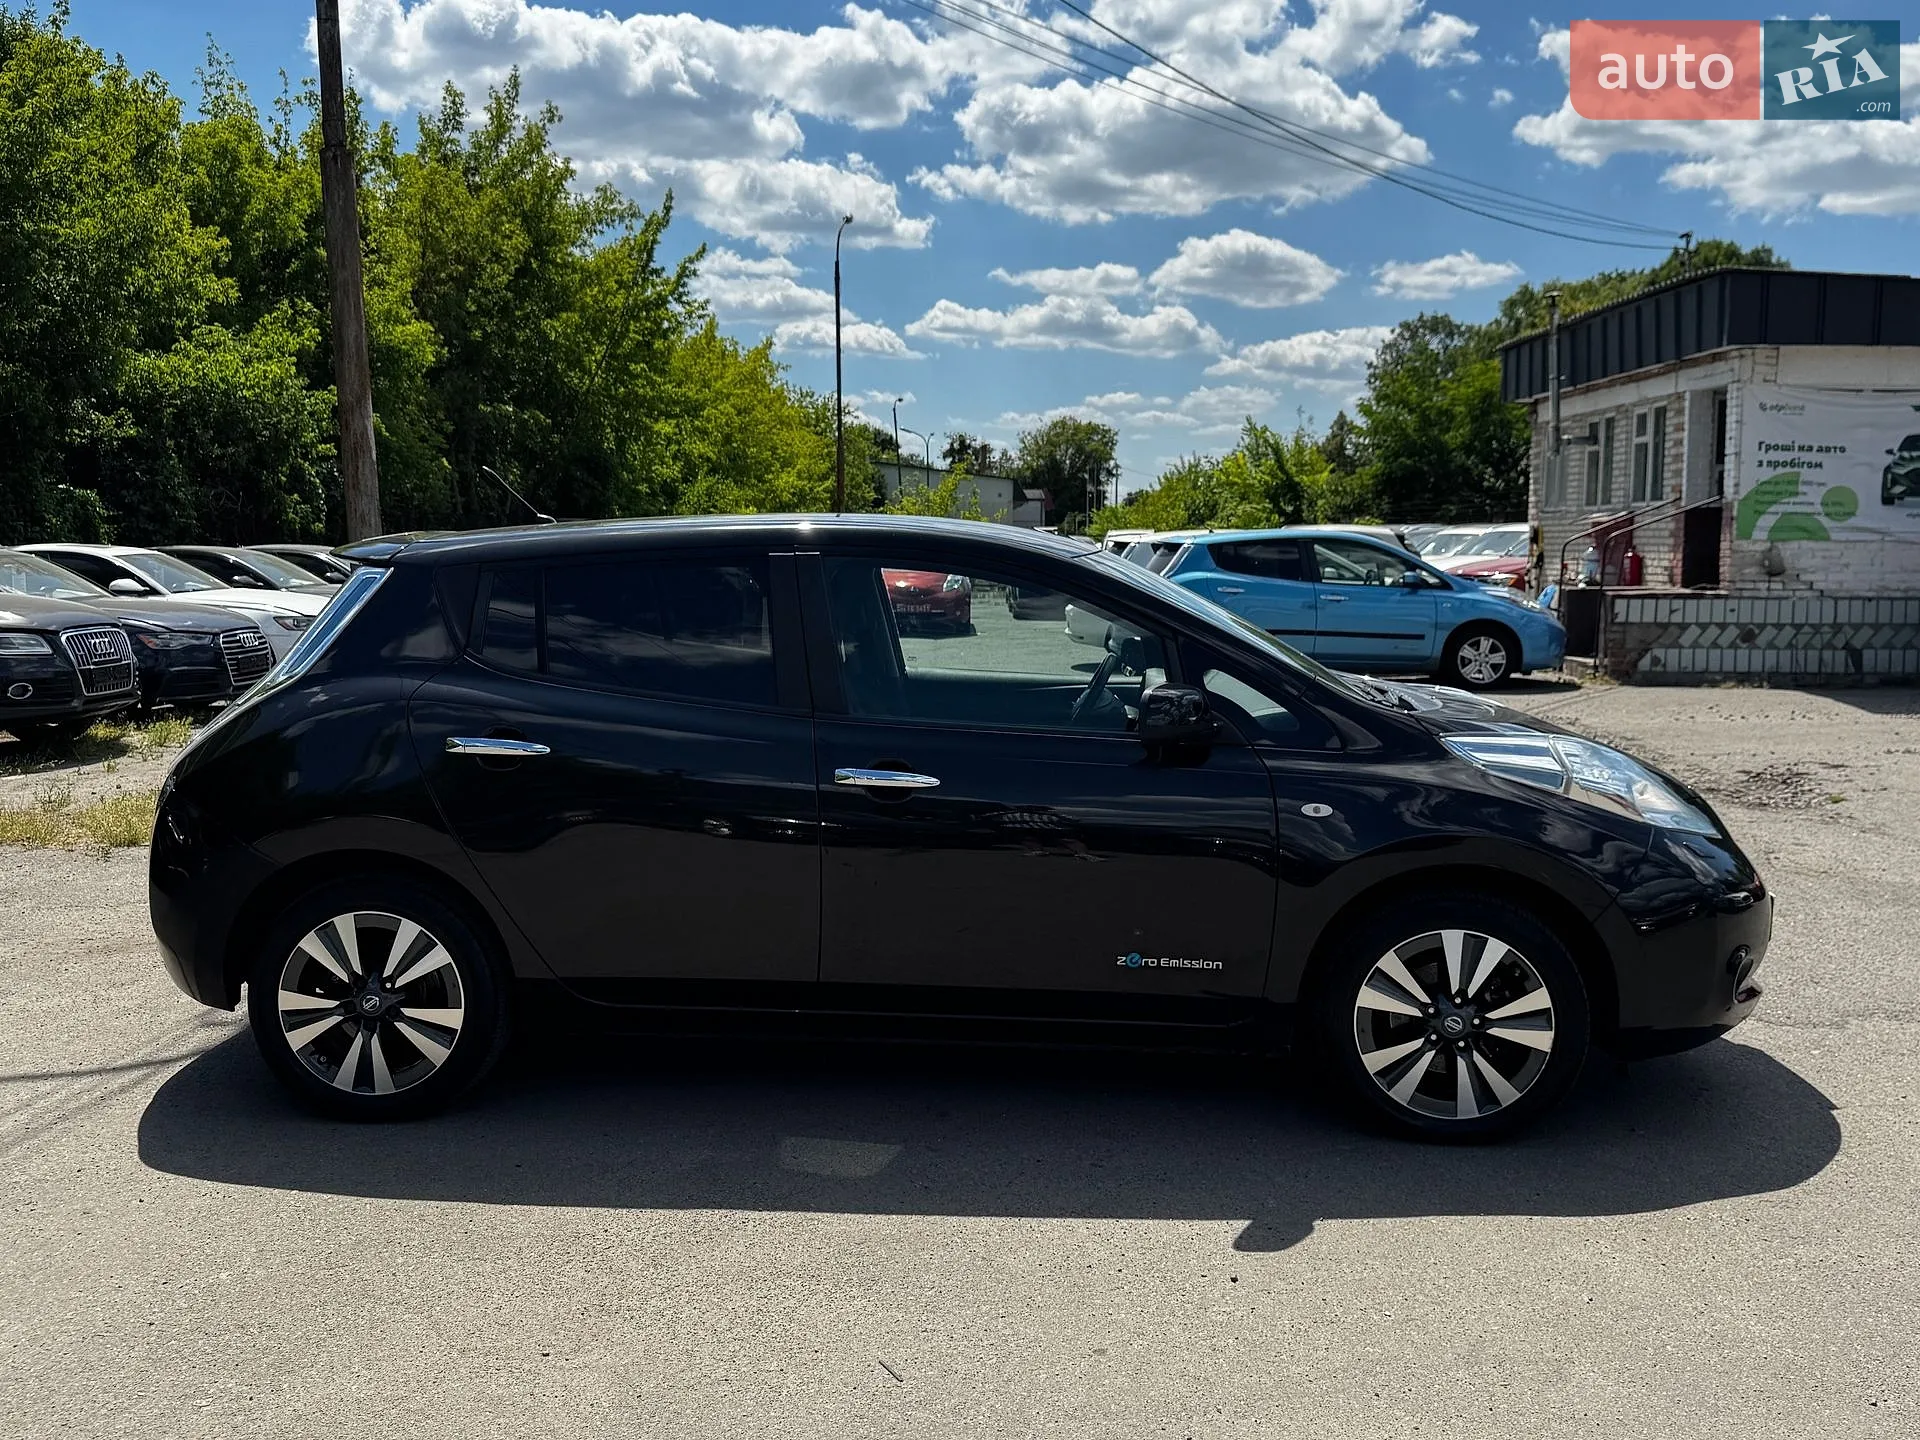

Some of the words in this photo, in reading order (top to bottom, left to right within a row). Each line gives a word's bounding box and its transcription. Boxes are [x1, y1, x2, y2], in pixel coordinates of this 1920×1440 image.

[1758, 440, 1796, 454] Гроші
[1797, 444, 1814, 453] на
[1816, 445, 1846, 454] авто
[1756, 459, 1764, 468] з
[1766, 457, 1823, 471] пробігом
[1160, 957, 1223, 970] Emission
